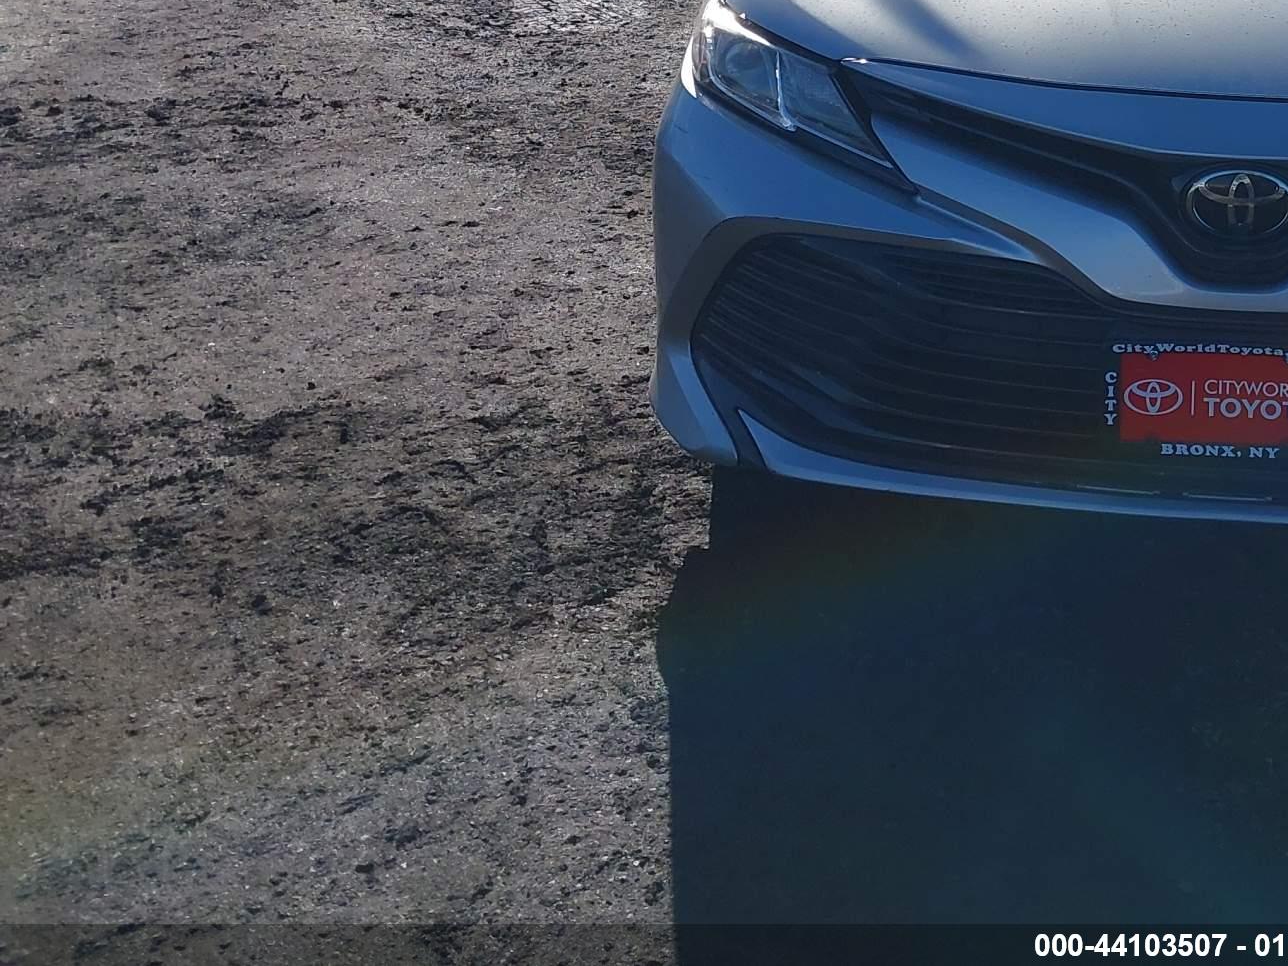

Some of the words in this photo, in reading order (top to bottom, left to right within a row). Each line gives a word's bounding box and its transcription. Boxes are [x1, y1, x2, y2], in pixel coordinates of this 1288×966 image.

[1104, 371, 1118, 426] CITY
[1160, 443, 1243, 459] BRONX,
[1249, 446, 1281, 459] NY
